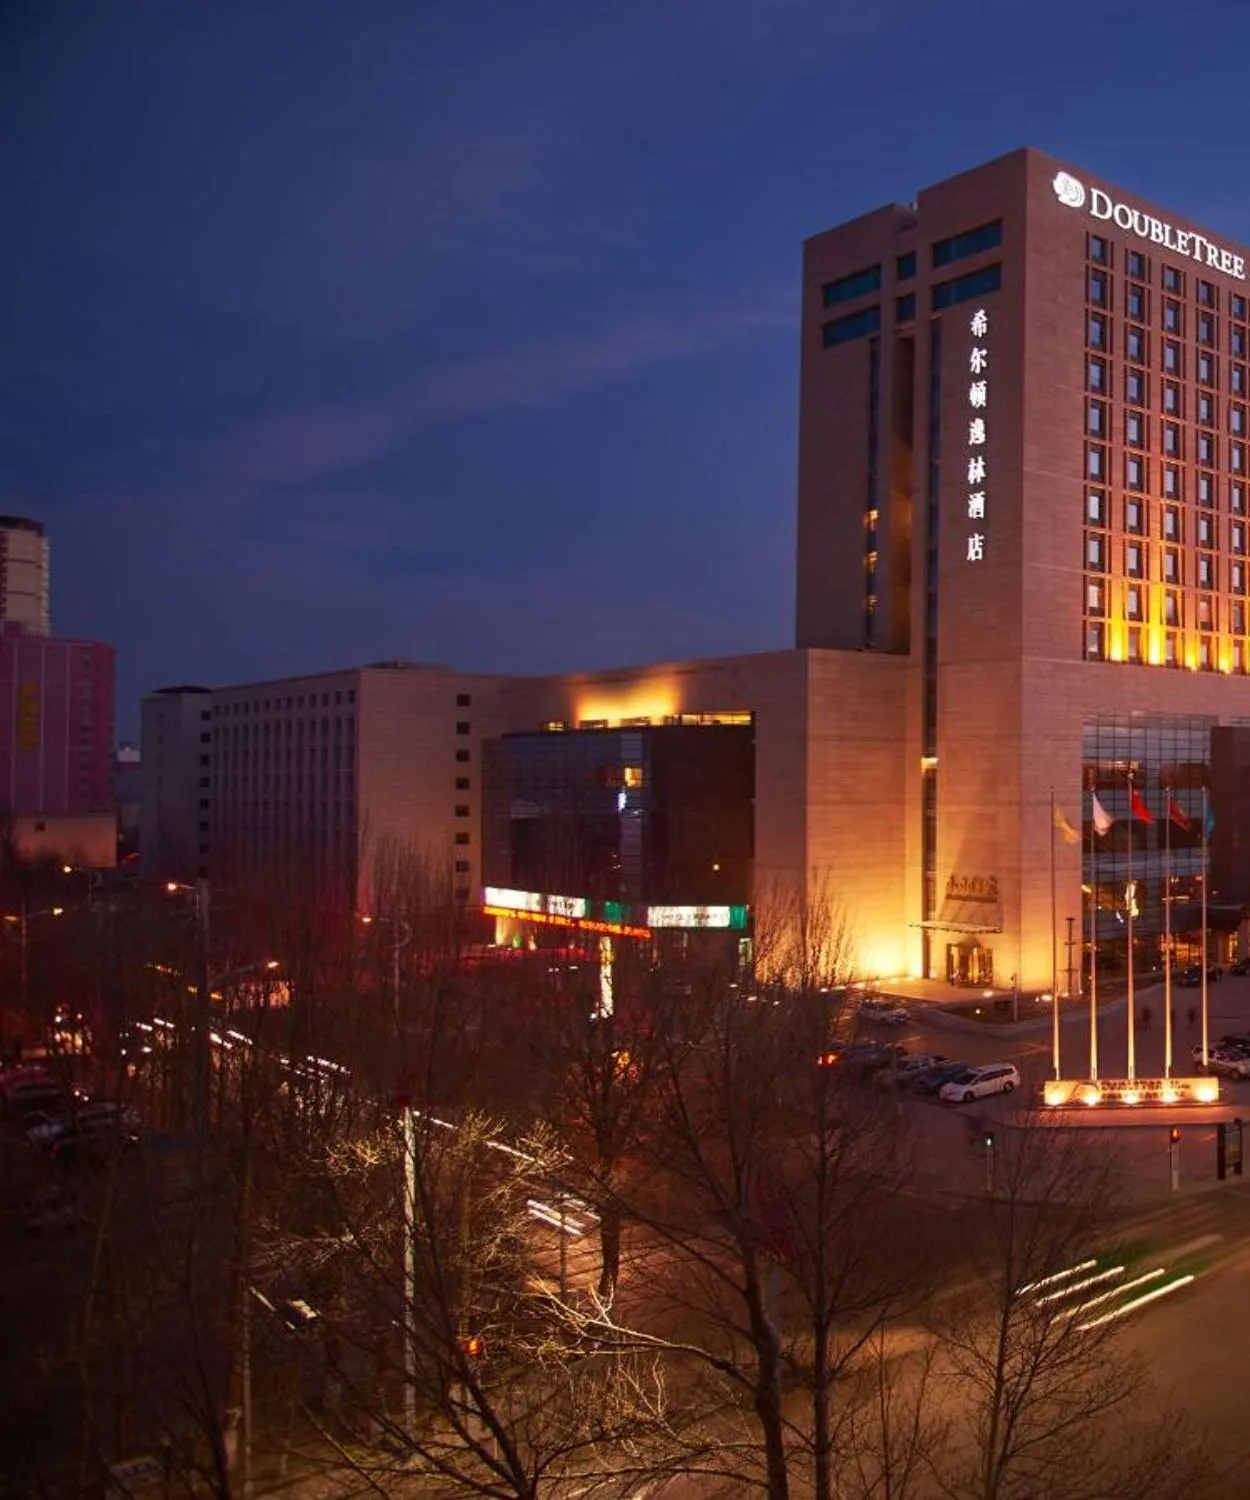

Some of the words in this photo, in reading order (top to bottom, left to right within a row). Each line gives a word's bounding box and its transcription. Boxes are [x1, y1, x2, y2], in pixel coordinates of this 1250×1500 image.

[1089, 187, 1246, 280] DOUBLETREE
[966, 309, 989, 562] 希尔顿逸林酒店
